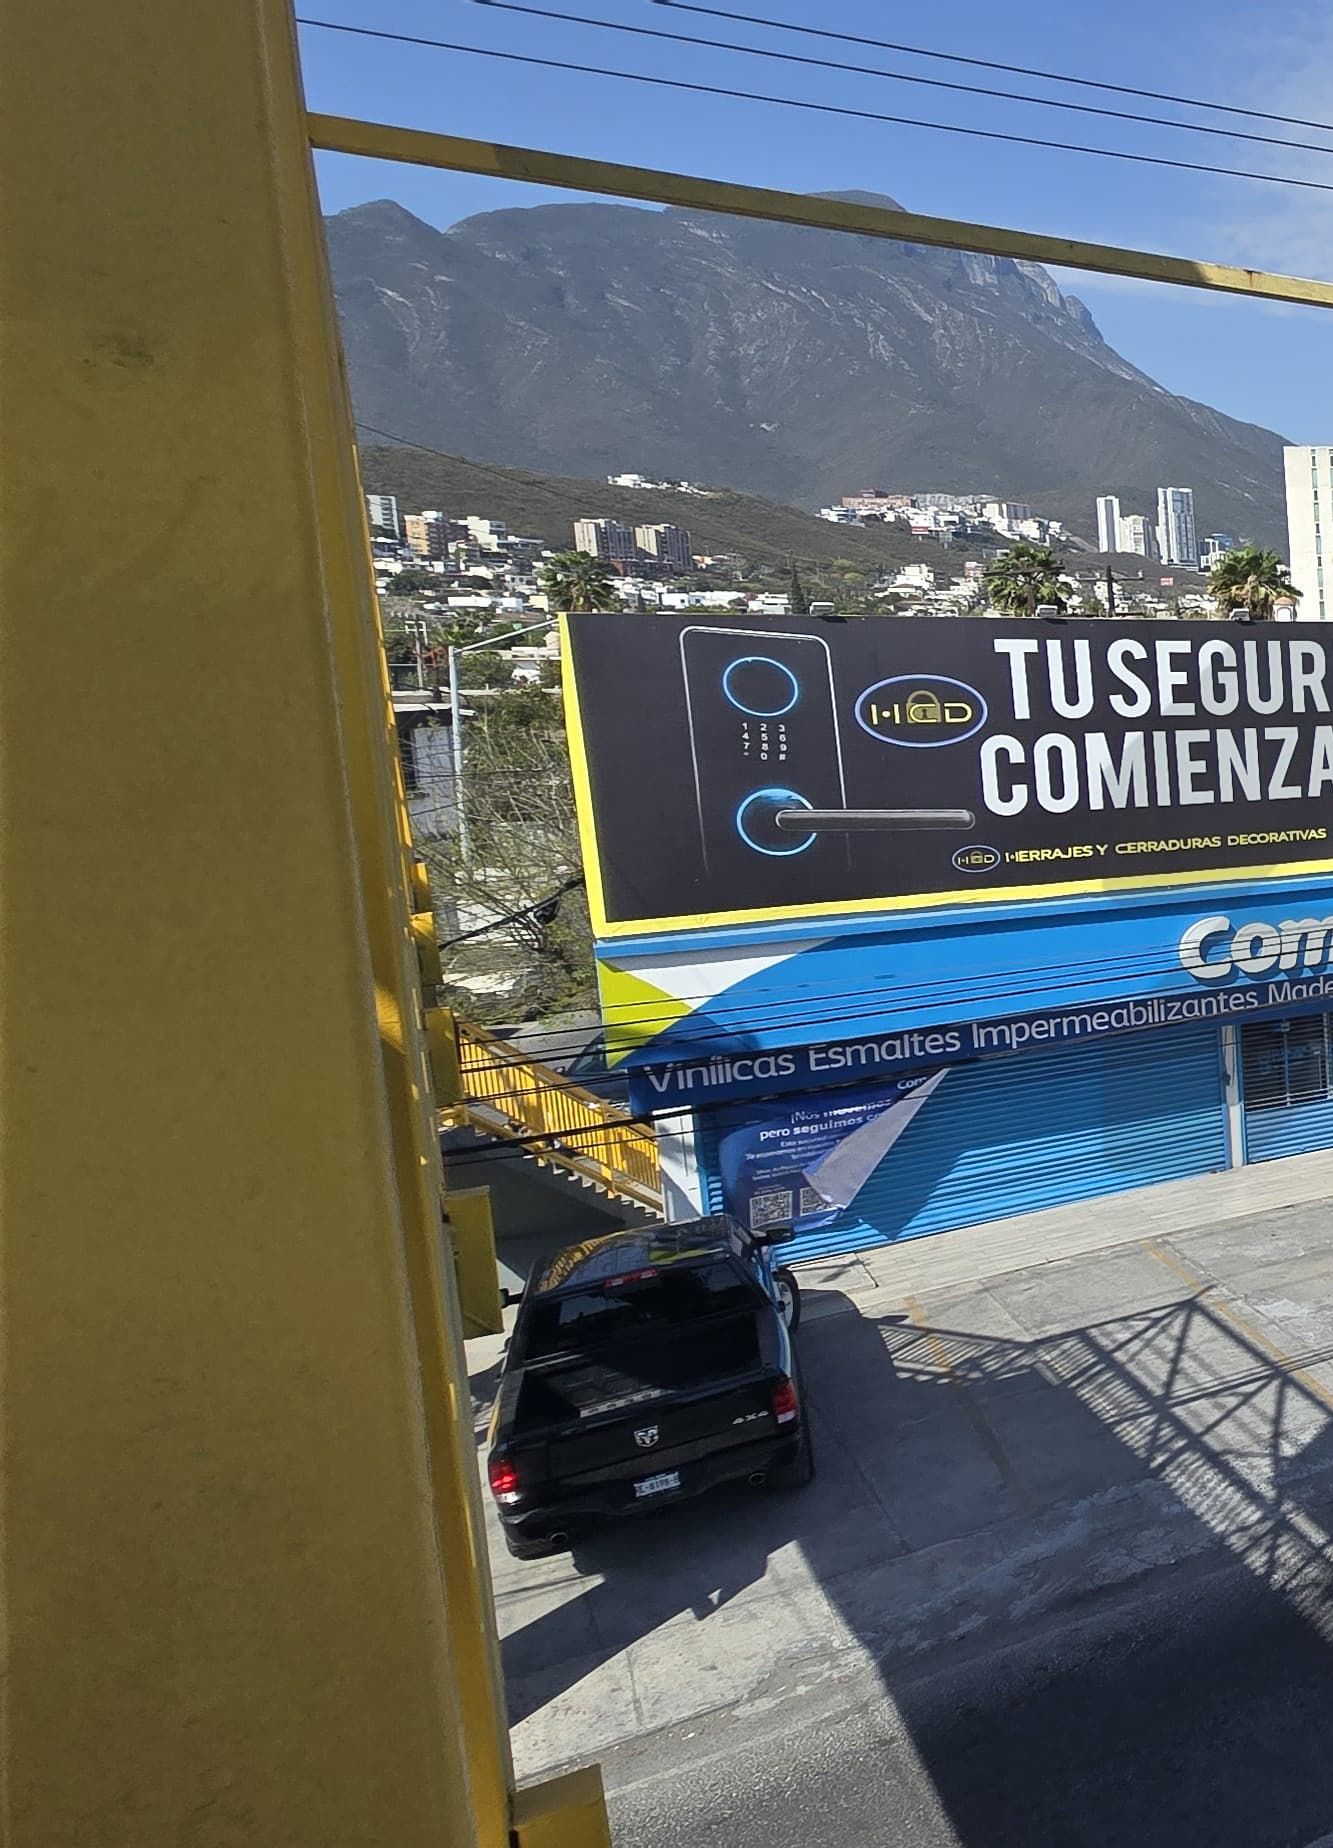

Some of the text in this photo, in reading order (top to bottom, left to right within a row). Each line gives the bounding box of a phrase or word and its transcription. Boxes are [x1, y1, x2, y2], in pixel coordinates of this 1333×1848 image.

[993, 637, 1095, 722] TU
[1004, 843, 1095, 865] HERRAJES
[1095, 842, 1109, 858] Y
[1114, 834, 1223, 856] CERRADURAS
[1226, 826, 1329, 848] DECORATIVAS
[808, 1028, 962, 1074] Esmaltes
[971, 988, 1260, 1052] Impermeabilizantes
[759, 1127, 790, 1142] pero
[792, 1115, 864, 1135] seguimos
